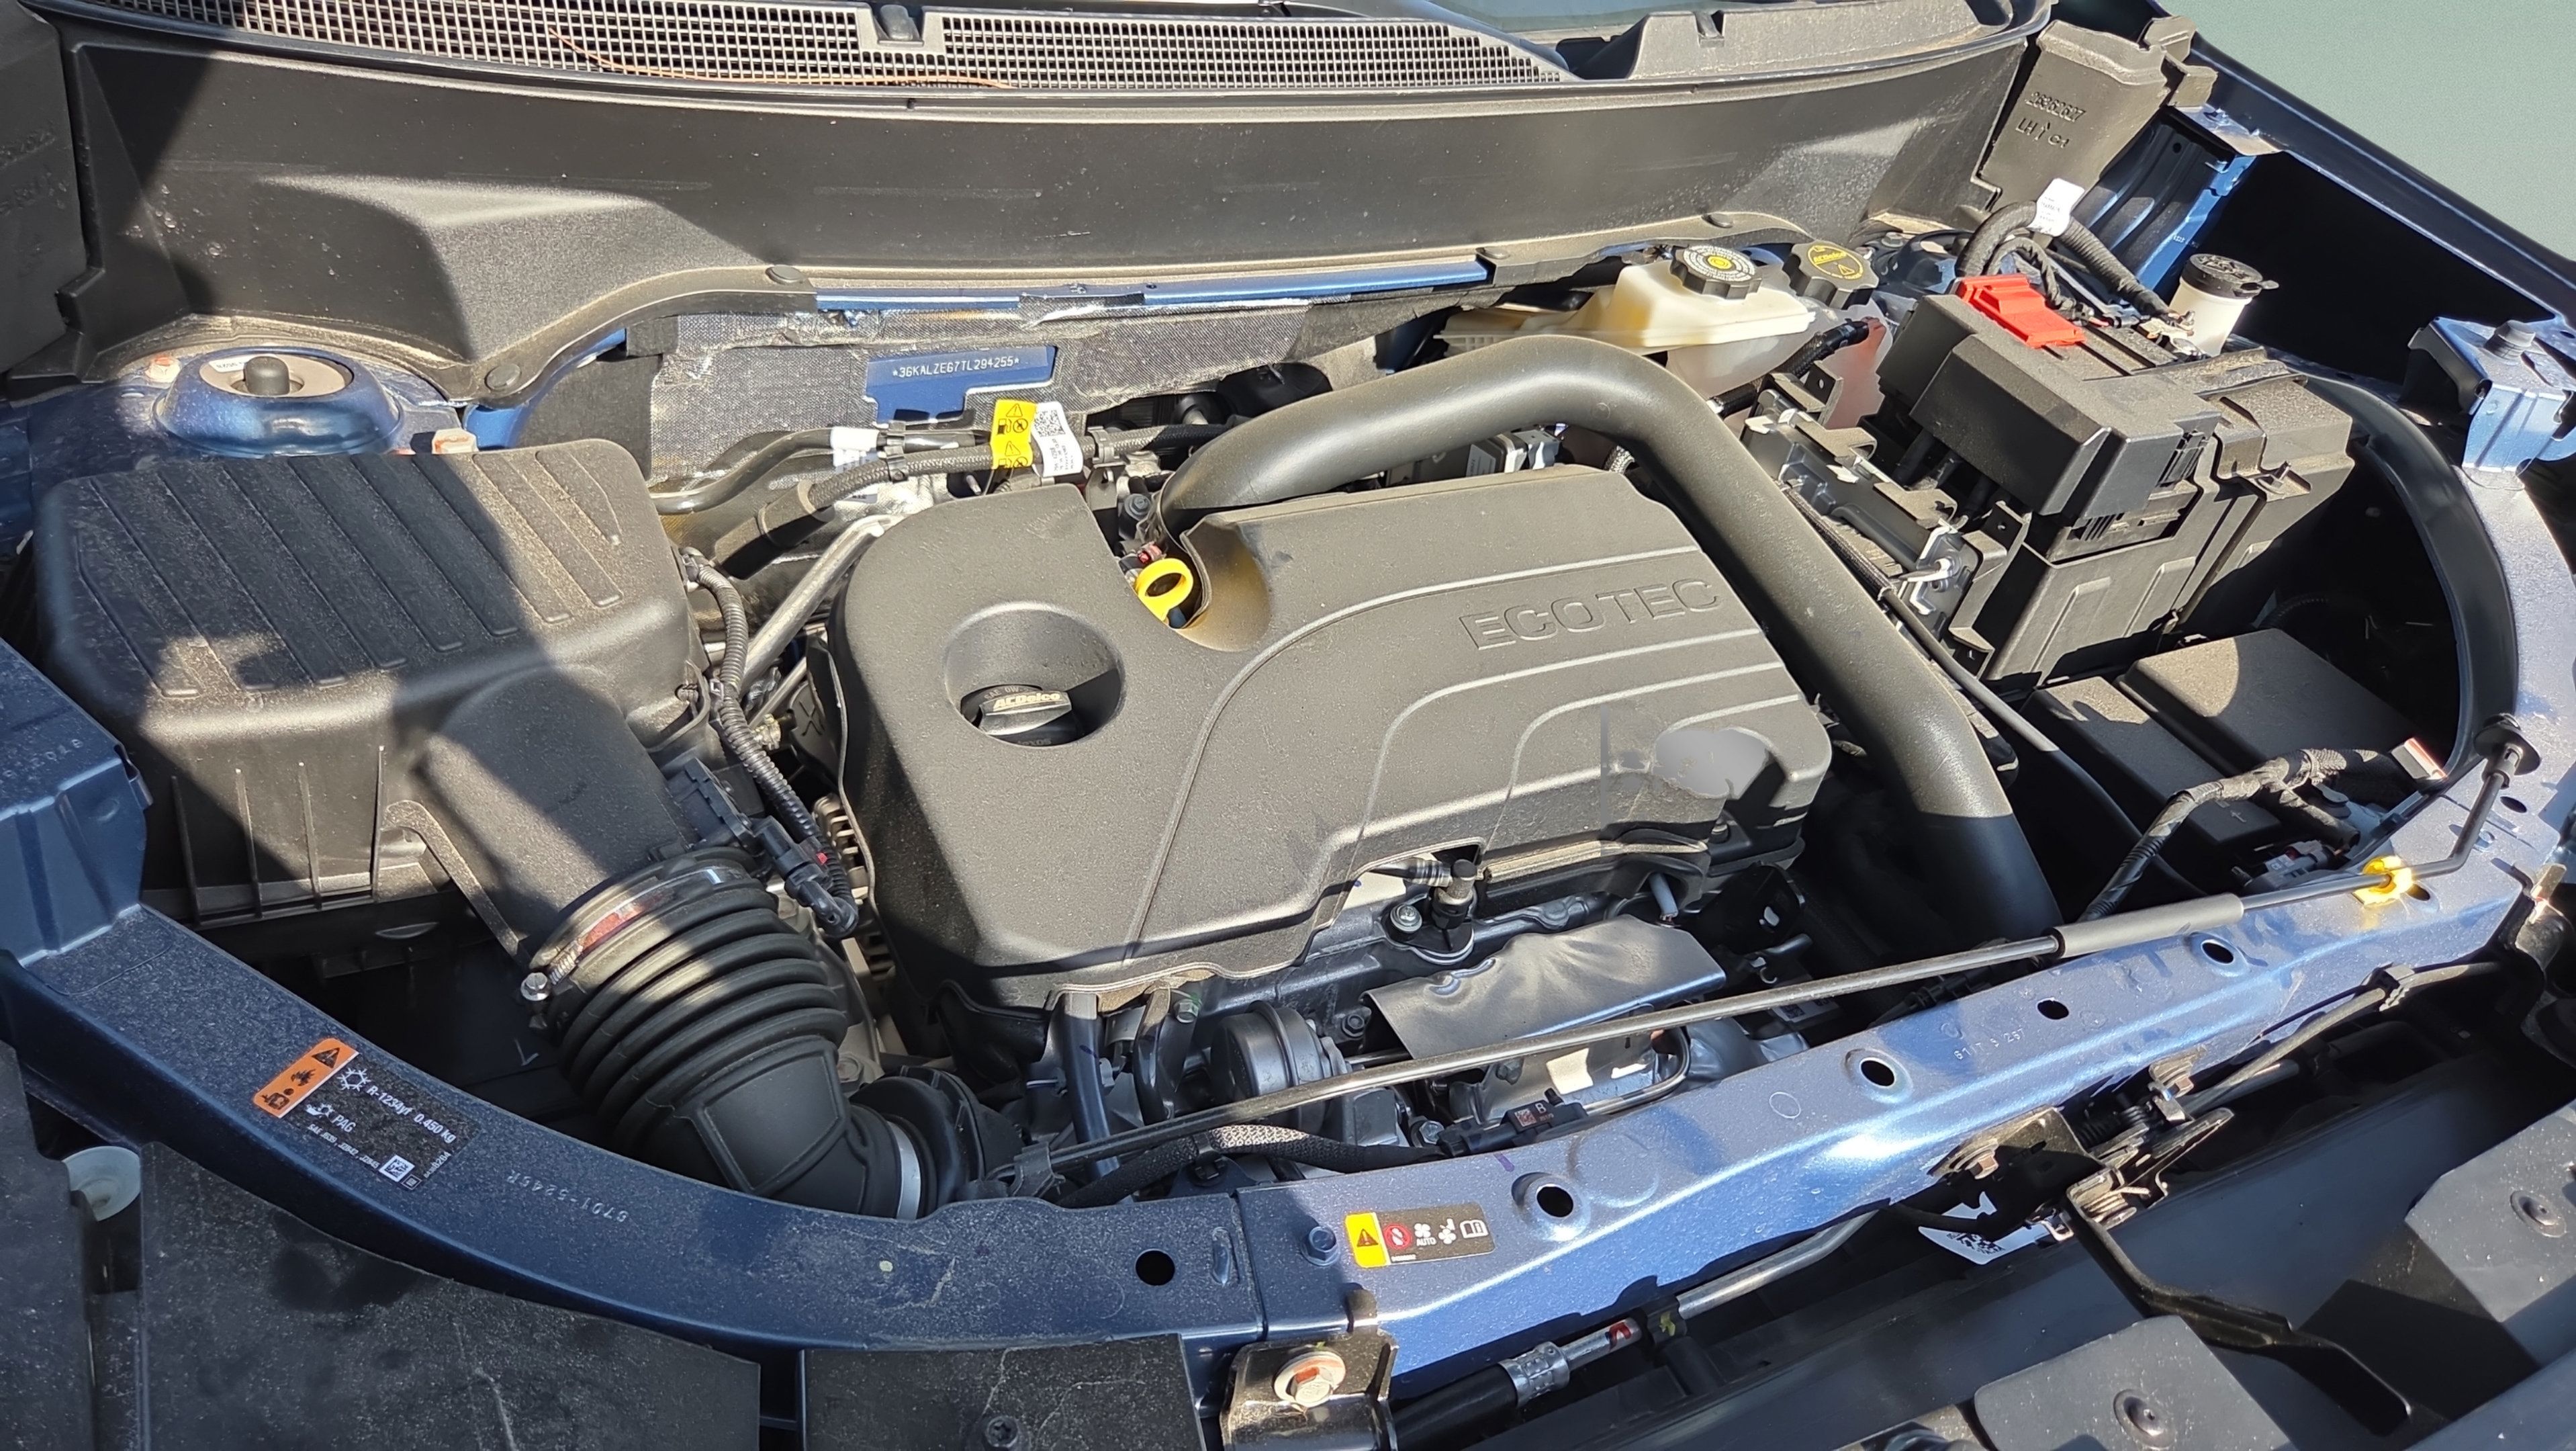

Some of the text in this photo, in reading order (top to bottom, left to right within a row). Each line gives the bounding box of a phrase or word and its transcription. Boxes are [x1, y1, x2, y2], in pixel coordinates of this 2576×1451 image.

[1459, 577, 1719, 651] ECOTEC
[984, 689, 1001, 700] SAE
[993, 693, 1061, 711] ACDelco
[367, 1085, 457, 1143] R-1234yf 0.450 kg
[308, 1123, 323, 1135] SAE
[331, 1114, 357, 1133] PAG
[1416, 1236, 1437, 1247] AUTO
